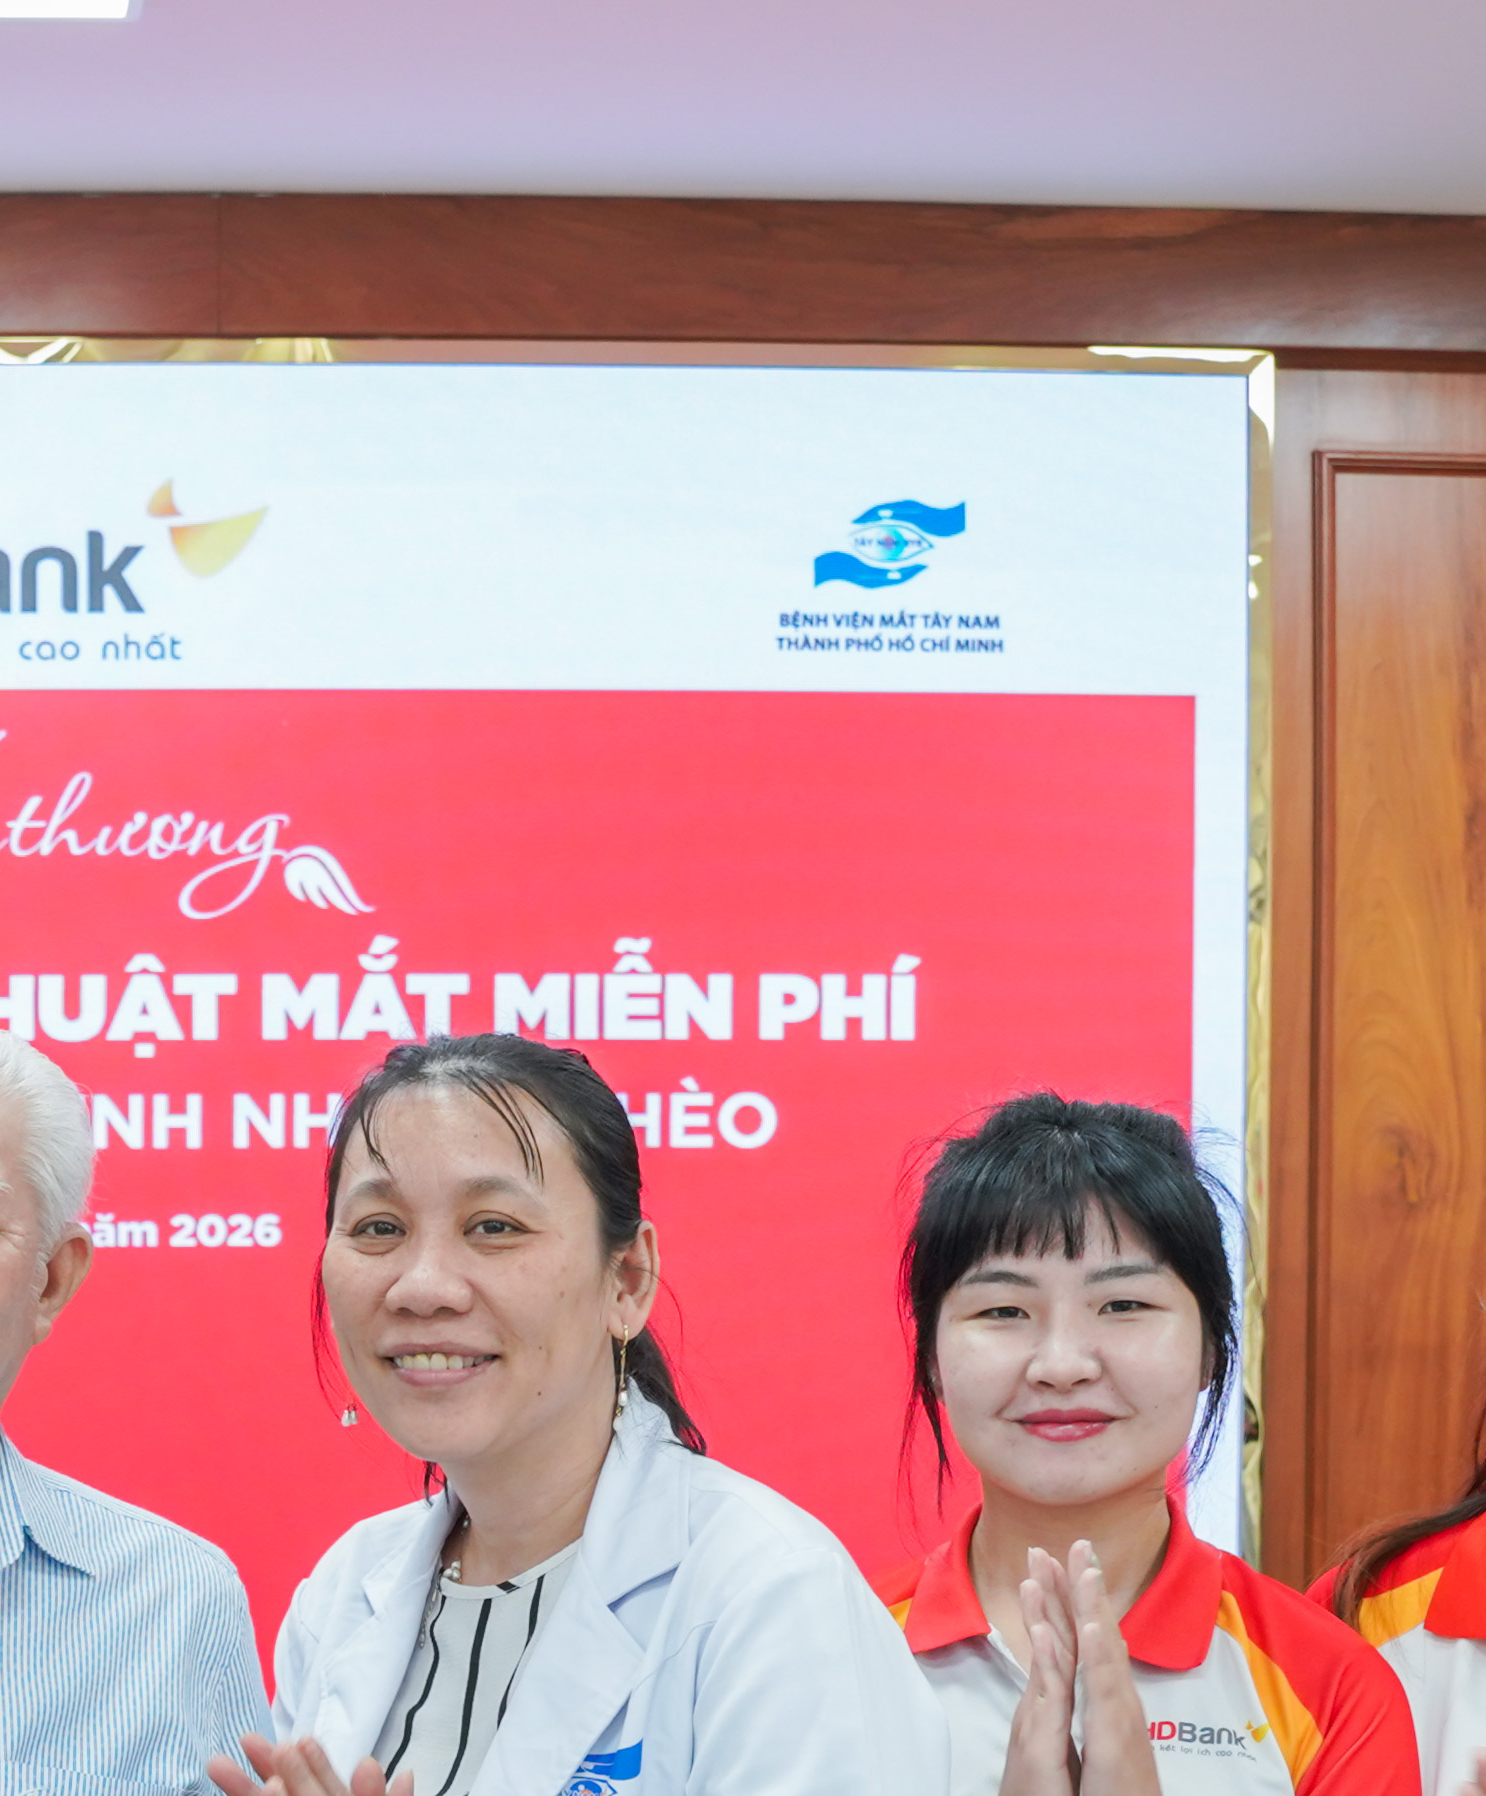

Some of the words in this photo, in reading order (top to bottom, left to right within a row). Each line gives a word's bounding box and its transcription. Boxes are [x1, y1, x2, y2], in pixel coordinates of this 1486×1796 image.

[779, 610, 828, 631] BỆNH
[833, 610, 874, 631] VIỆN
[958, 614, 1001, 630] NAM
[18, 640, 80, 661] cao
[101, 632, 183, 661] nhất
[776, 634, 841, 651] THÀNH
[845, 633, 883, 651] PHỐ
[921, 634, 950, 652] CHÍ
[956, 638, 1004, 653] MINH
[261, 934, 471, 1041] MẮT
[493, 935, 731, 1042] MIỄN
[757, 953, 922, 1041] PHÍ
[616, 1075, 779, 1150] HÈO
[168, 1213, 284, 1248] 2026
